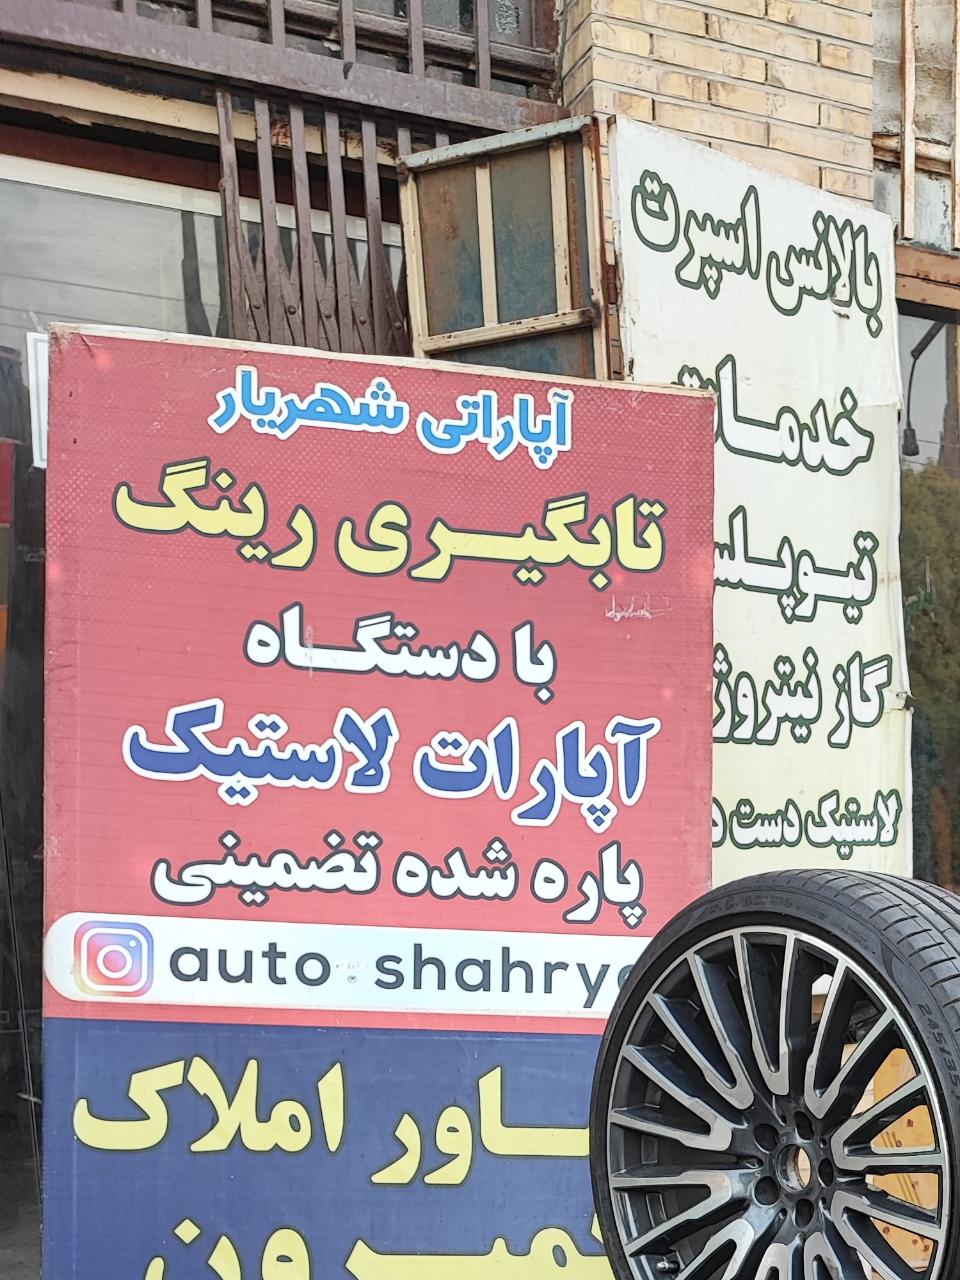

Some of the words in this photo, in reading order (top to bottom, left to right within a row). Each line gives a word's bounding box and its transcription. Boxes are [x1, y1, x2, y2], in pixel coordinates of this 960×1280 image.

[631, 170, 762, 299] اسپرت
[766, 211, 883, 337] بالانس
[206, 366, 409, 438] شهریار
[416, 390, 573, 470] آپاراتی
[678, 354, 874, 476] خدما
[112, 457, 319, 570] رینگ
[336, 493, 667, 591] تابگیری
[243, 602, 499, 685] دستگاه
[512, 622, 557, 704] با
[712, 642, 822, 746] نیتروژ
[828, 651, 892, 748] گاز
[122, 698, 400, 806] لاستیک
[413, 715, 662, 832] آپارات
[149, 828, 382, 908] تضمینی
[392, 836, 518, 903] شده
[729, 798, 802, 850] دست
[804, 788, 902, 861] لاستیک
[530, 840, 644, 928] پاره
[72, 1057, 347, 1157] املاک
